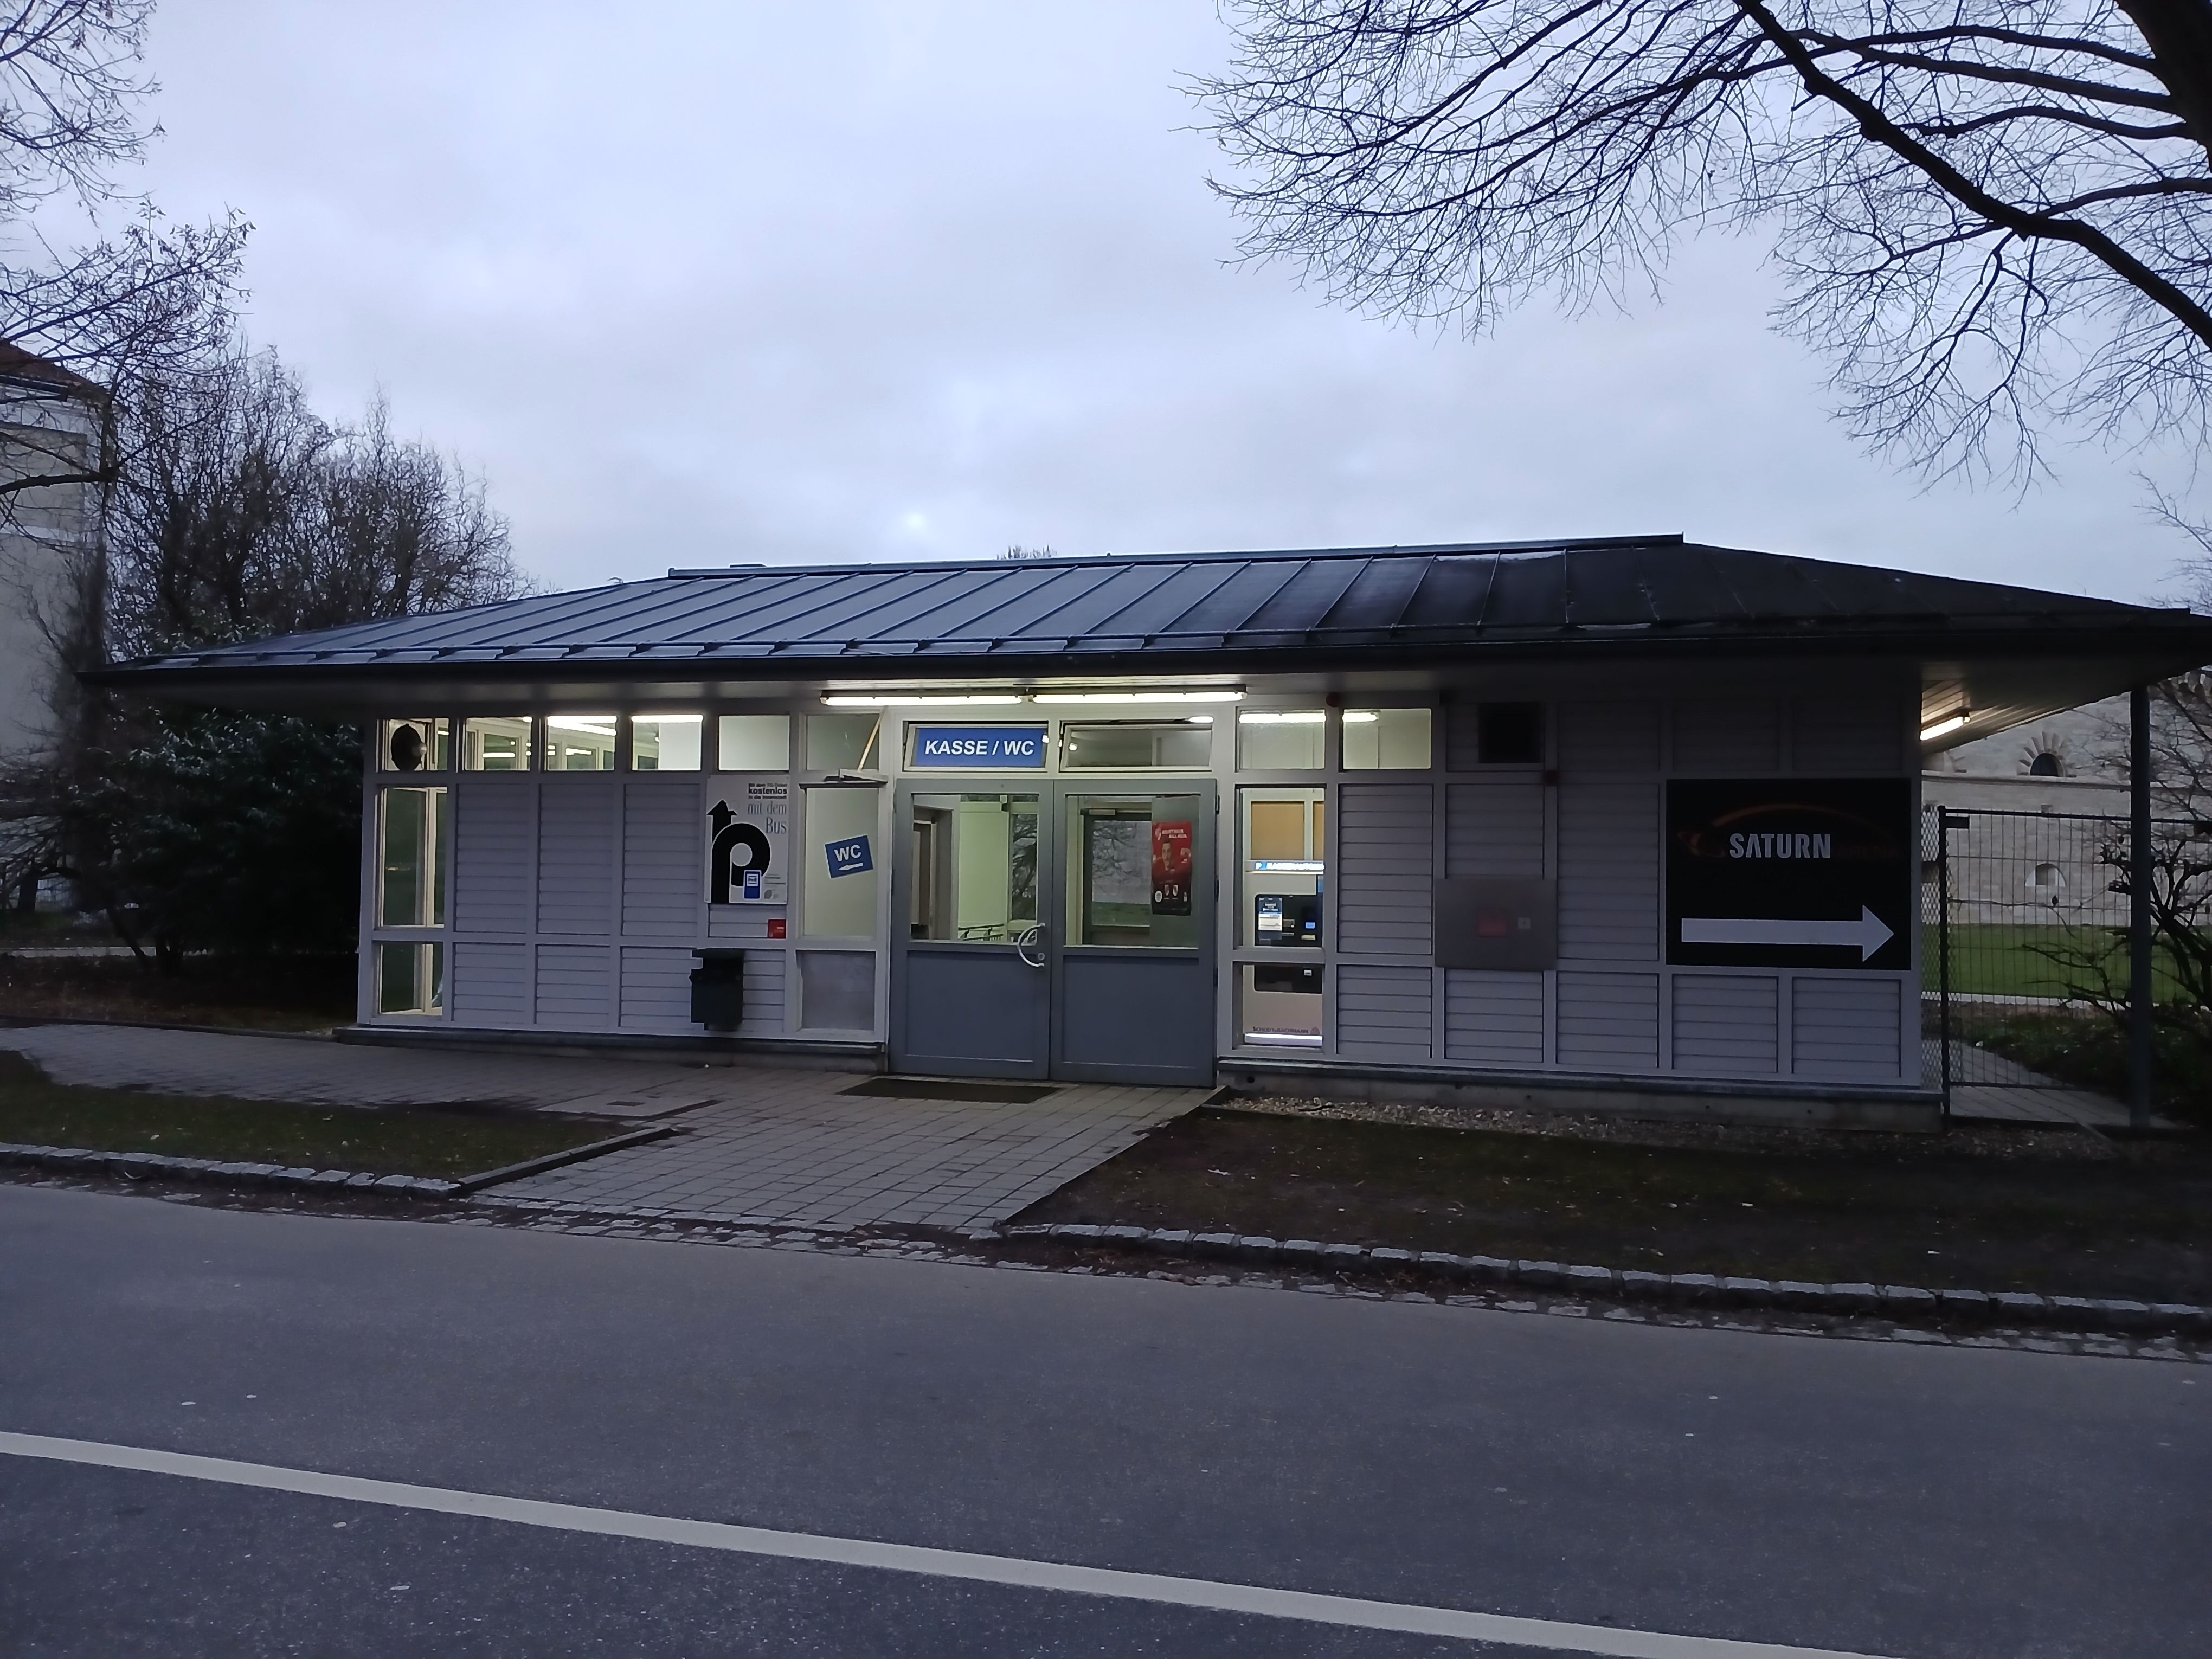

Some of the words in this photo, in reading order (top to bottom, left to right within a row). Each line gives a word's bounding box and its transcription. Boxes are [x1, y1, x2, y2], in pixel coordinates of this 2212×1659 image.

[925, 740, 988, 755] KASSE
[992, 741, 999, 755] /
[1004, 740, 1035, 755] WC
[748, 786, 787, 795] kostenlos
[748, 801, 762, 815] mit
[767, 800, 787, 815] dem
[766, 816, 787, 835] Bus
[834, 844, 862, 862] WC
[1729, 833, 1831, 859] SATURN
